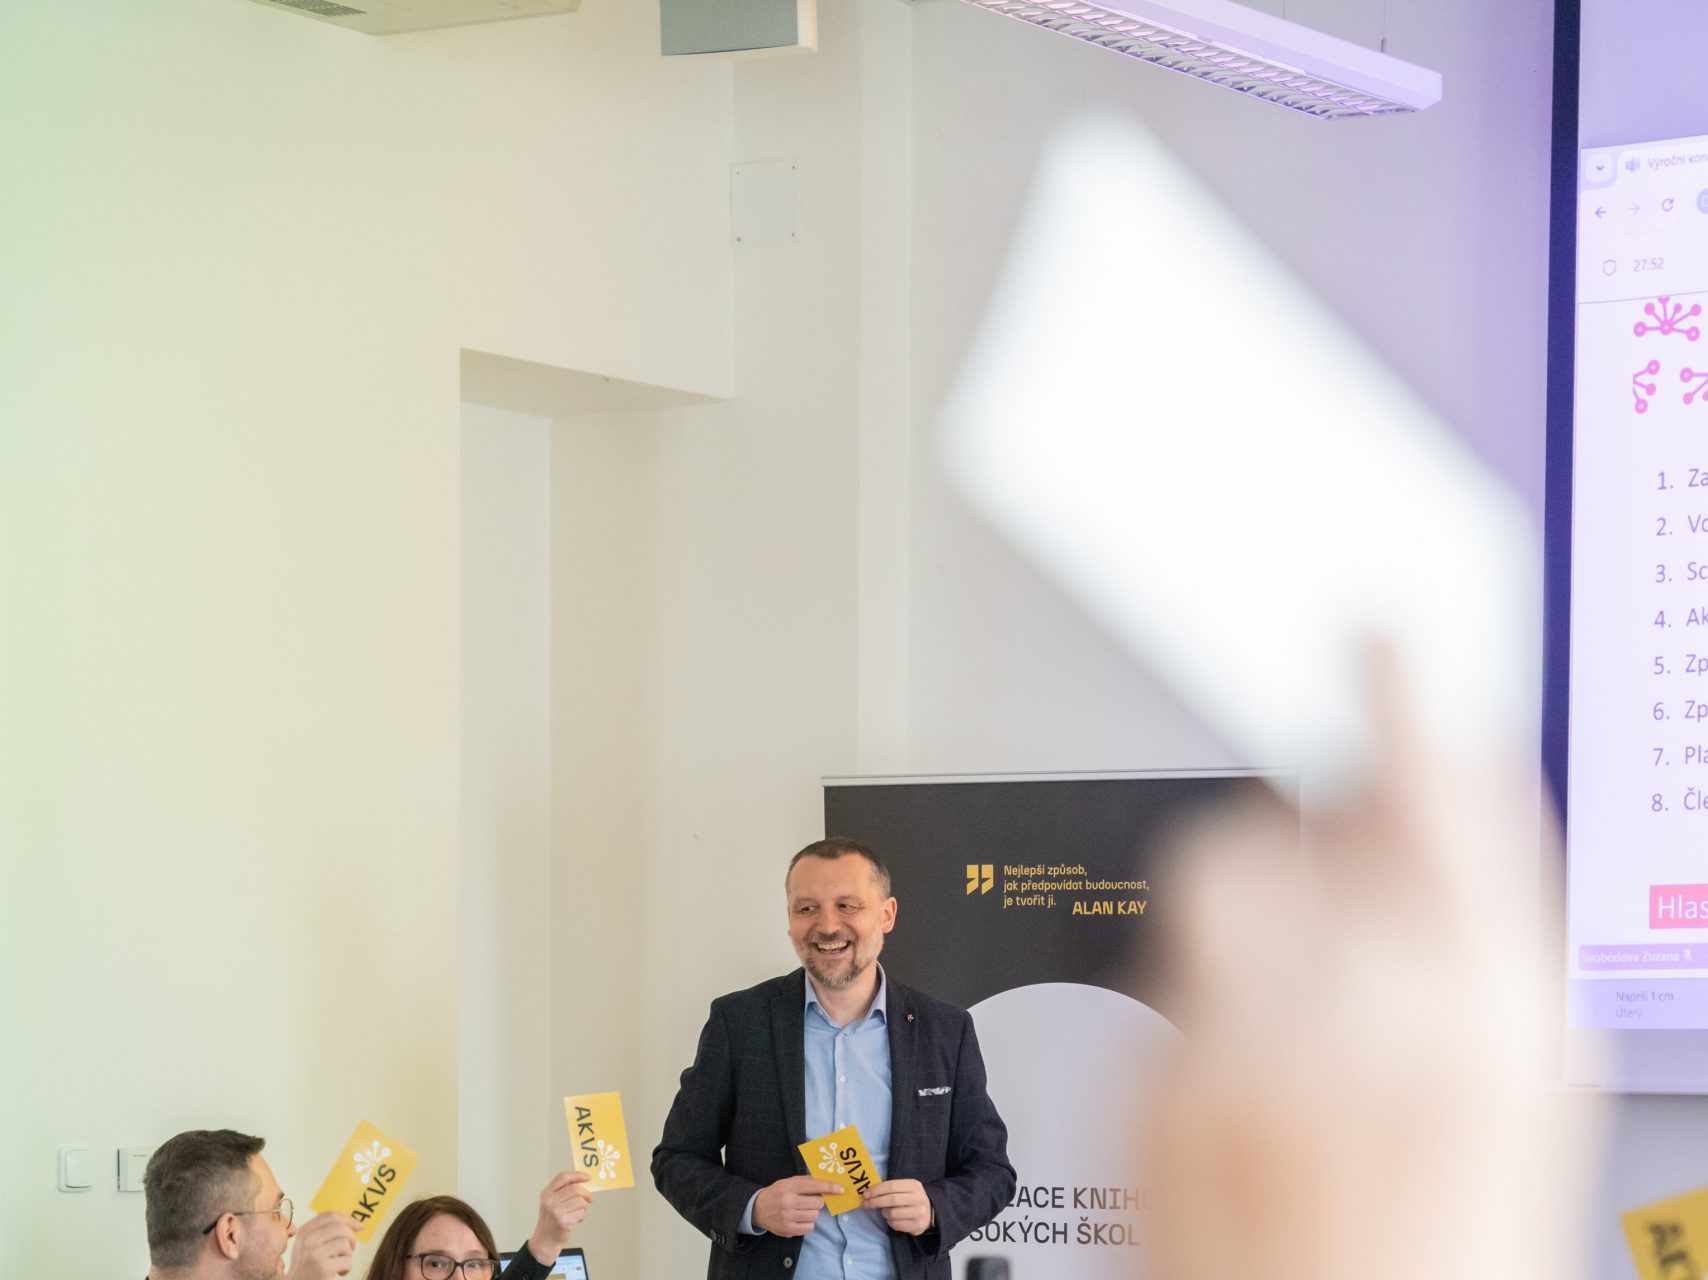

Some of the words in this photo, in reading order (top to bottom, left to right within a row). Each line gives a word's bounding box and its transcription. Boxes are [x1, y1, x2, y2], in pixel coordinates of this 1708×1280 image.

[1632, 257, 1665, 273] 27:52
[1656, 471, 1674, 491] 1.
[1656, 516, 1673, 537] 2.
[1655, 564, 1672, 583] 3.
[1653, 609, 1672, 629] 4.
[1653, 656, 1671, 676] 5.
[1685, 654, 1708, 677] Zp
[1653, 702, 1670, 721] 6.
[1684, 700, 1708, 722] Zp
[1652, 748, 1670, 767] 7.
[1651, 793, 1669, 812] 8.
[1003, 864, 1046, 878] Nejlepší
[1047, 863, 1088, 878] způsob,
[1003, 879, 1019, 894] jak
[1021, 879, 1083, 894] předpovídat
[1085, 878, 1150, 892] budoucnost,
[1003, 895, 1014, 909] je
[1015, 894, 1046, 907] tvořit
[1072, 900, 1114, 916] ALAN
[1117, 900, 1148, 915] KAY
[1616, 990, 1648, 1004] Naprší
[1658, 992, 1675, 1002] cm
[574, 1105, 599, 1169] AKVS
[351, 1163, 397, 1223] AKVS
[1005, 1186, 1065, 1209] ACE
[1076, 1216, 1141, 1246] ŠKOL
